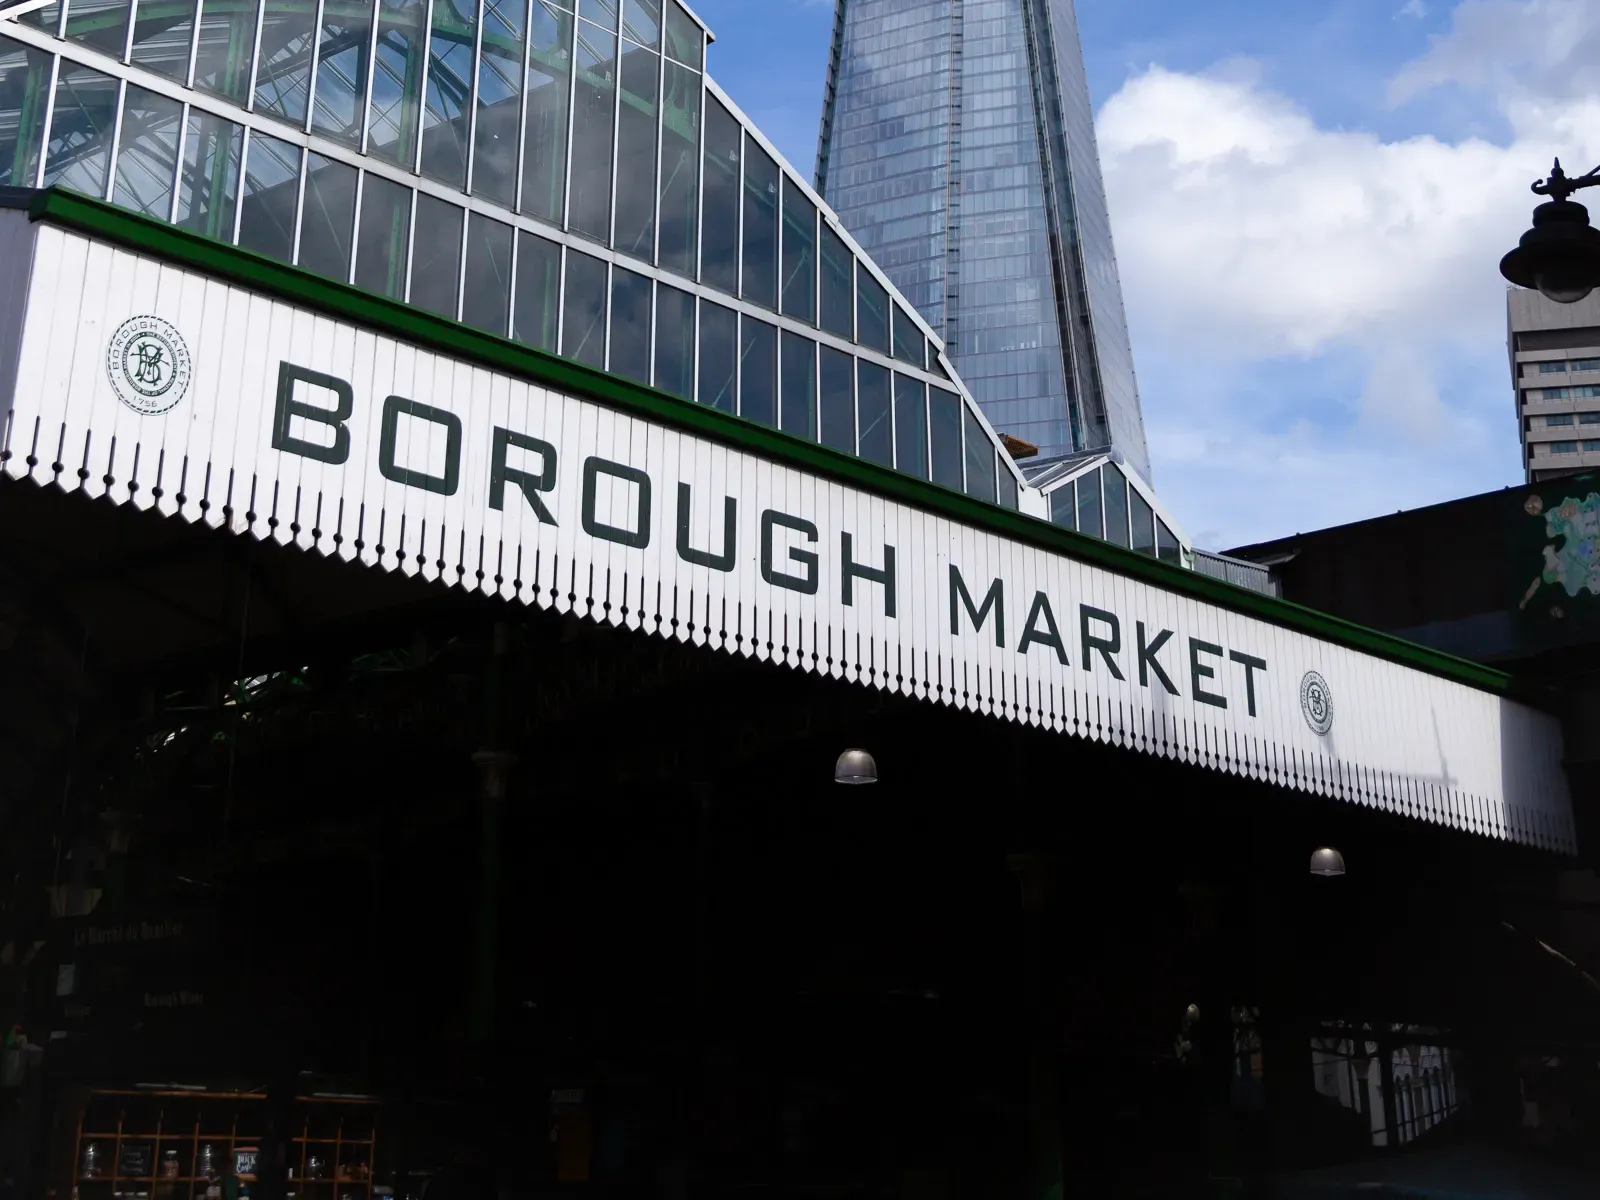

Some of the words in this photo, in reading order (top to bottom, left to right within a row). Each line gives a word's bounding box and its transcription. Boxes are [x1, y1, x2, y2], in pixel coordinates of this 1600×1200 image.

[112, 320, 158, 370] BOROUGH
[163, 328, 187, 389] MARKET
[132, 395, 158, 408] 1756
[271, 359, 897, 619] BOROUGH
[948, 563, 1268, 718] MARKET
